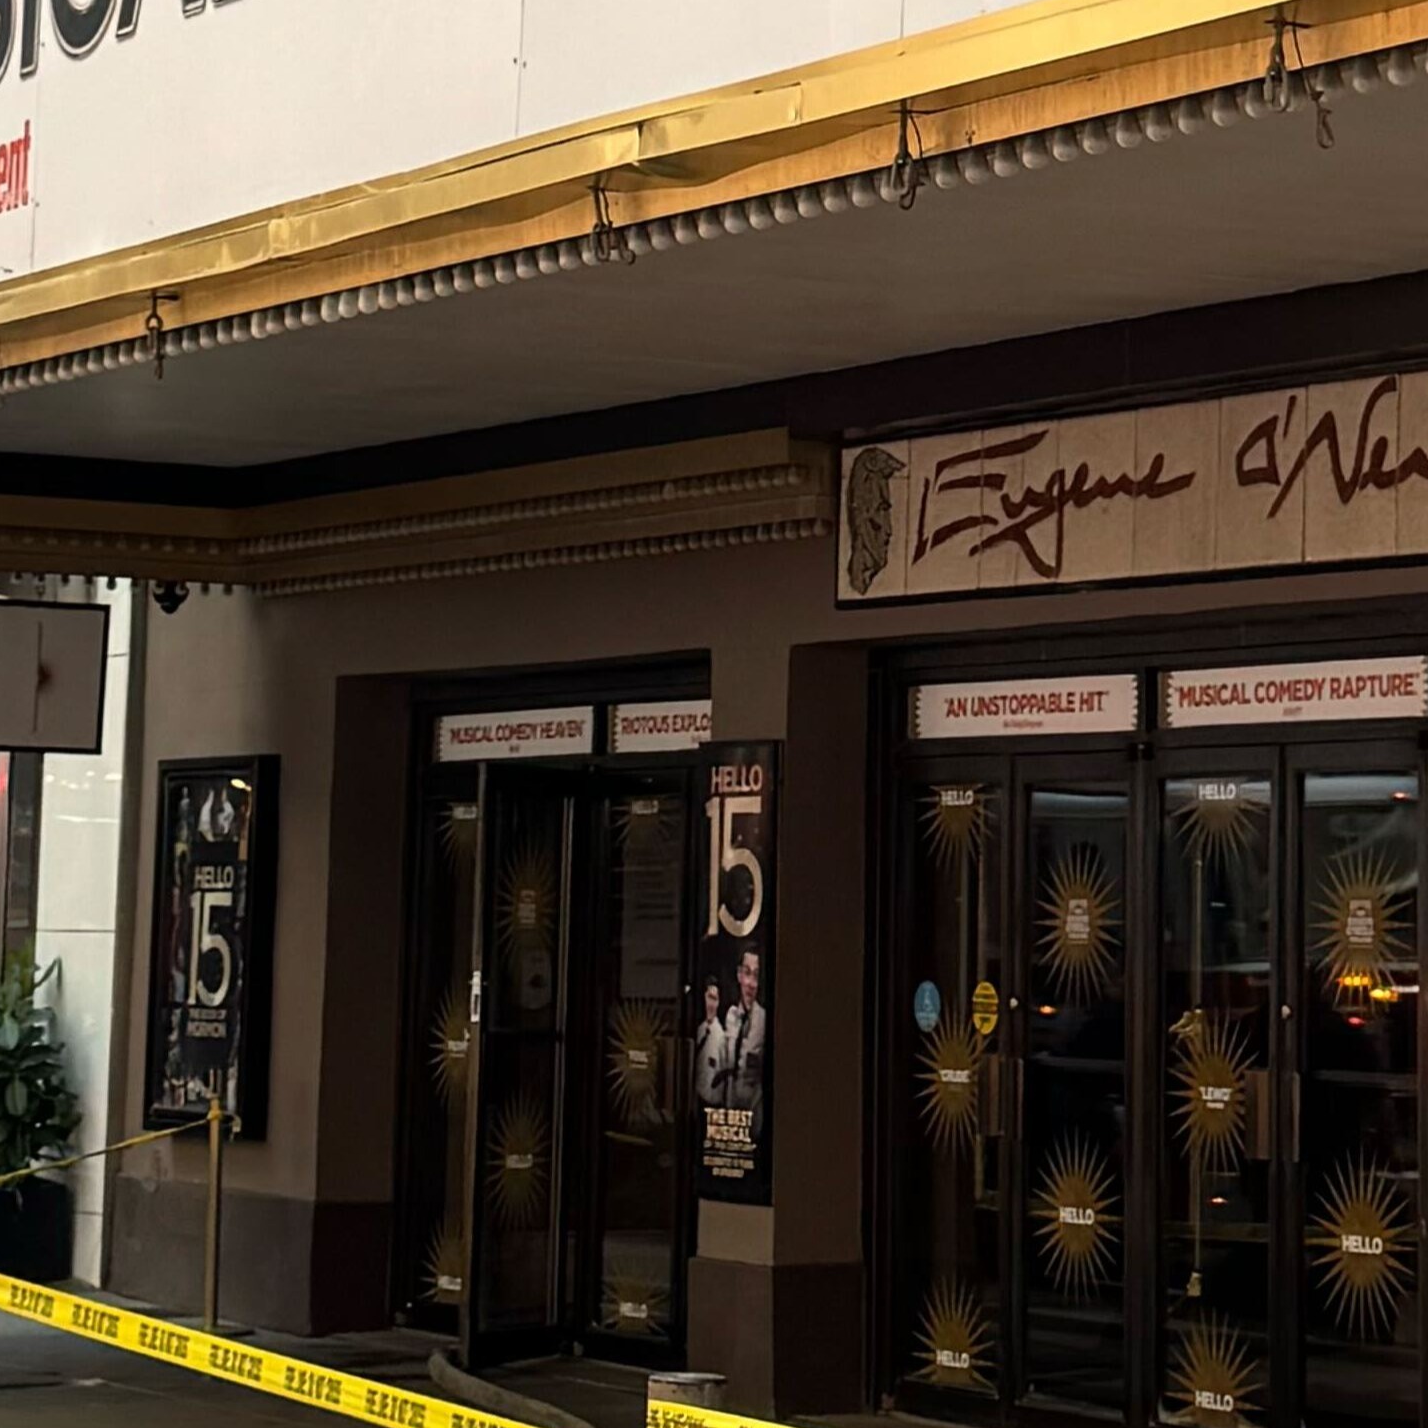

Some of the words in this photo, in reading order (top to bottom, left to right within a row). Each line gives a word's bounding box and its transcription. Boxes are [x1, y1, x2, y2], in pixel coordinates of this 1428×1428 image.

[911, 428, 1196, 579] Eugene
[1254, 678, 1326, 703] COMEDY
[971, 692, 1076, 718] UNSTOPPABLE
[711, 764, 762, 793] HELLO
[940, 789, 974, 806] HELLO
[1198, 784, 1236, 800] HELLO
[194, 866, 234, 889] HELLO
[705, 796, 763, 937] 15
[187, 891, 233, 1006] 15
[1058, 1206, 1095, 1225] HELLO
[1341, 1234, 1383, 1255] HELLO
[936, 1350, 970, 1369] HELLO
[1195, 1390, 1234, 1412] HELLO
